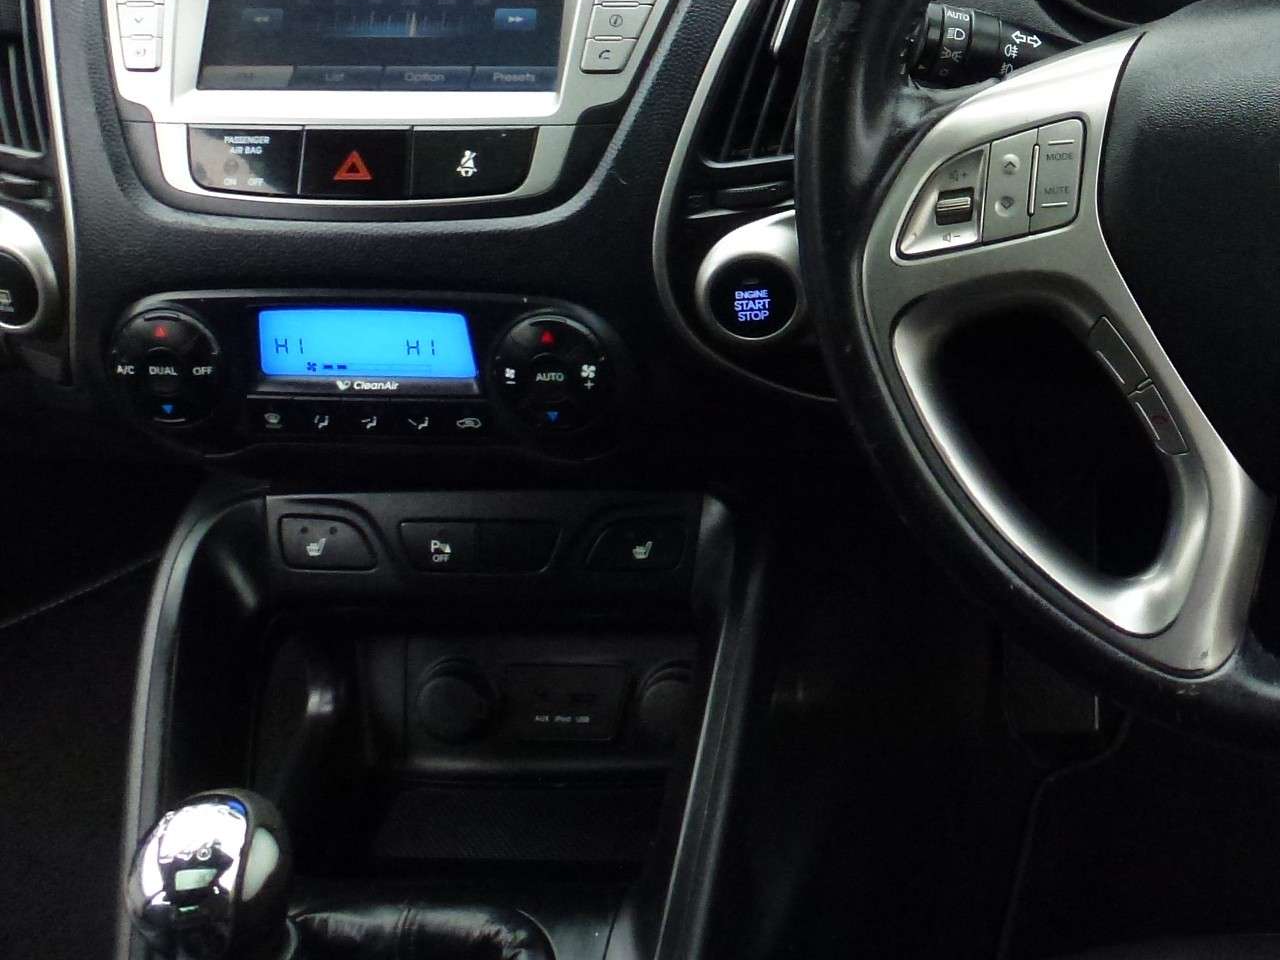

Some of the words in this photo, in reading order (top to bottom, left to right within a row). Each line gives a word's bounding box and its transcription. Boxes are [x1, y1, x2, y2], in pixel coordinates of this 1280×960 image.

[946, 10, 970, 21] AUTO
[404, 72, 445, 83] Option
[493, 71, 536, 82] Presets
[223, 136, 270, 144] PASSENGER
[245, 146, 262, 154] BAG
[1046, 152, 1073, 161] MODE
[1044, 186, 1069, 195] MUTE
[735, 290, 768, 299] ENGINE
[734, 299, 771, 311] START
[738, 311, 769, 321] STOP
[117, 365, 135, 375] A/C
[149, 366, 178, 376] DUAL
[192, 366, 213, 376] OFF
[536, 373, 564, 382] AUTO
[353, 381, 399, 390] CleanAir
[432, 554, 449, 562] OFF
